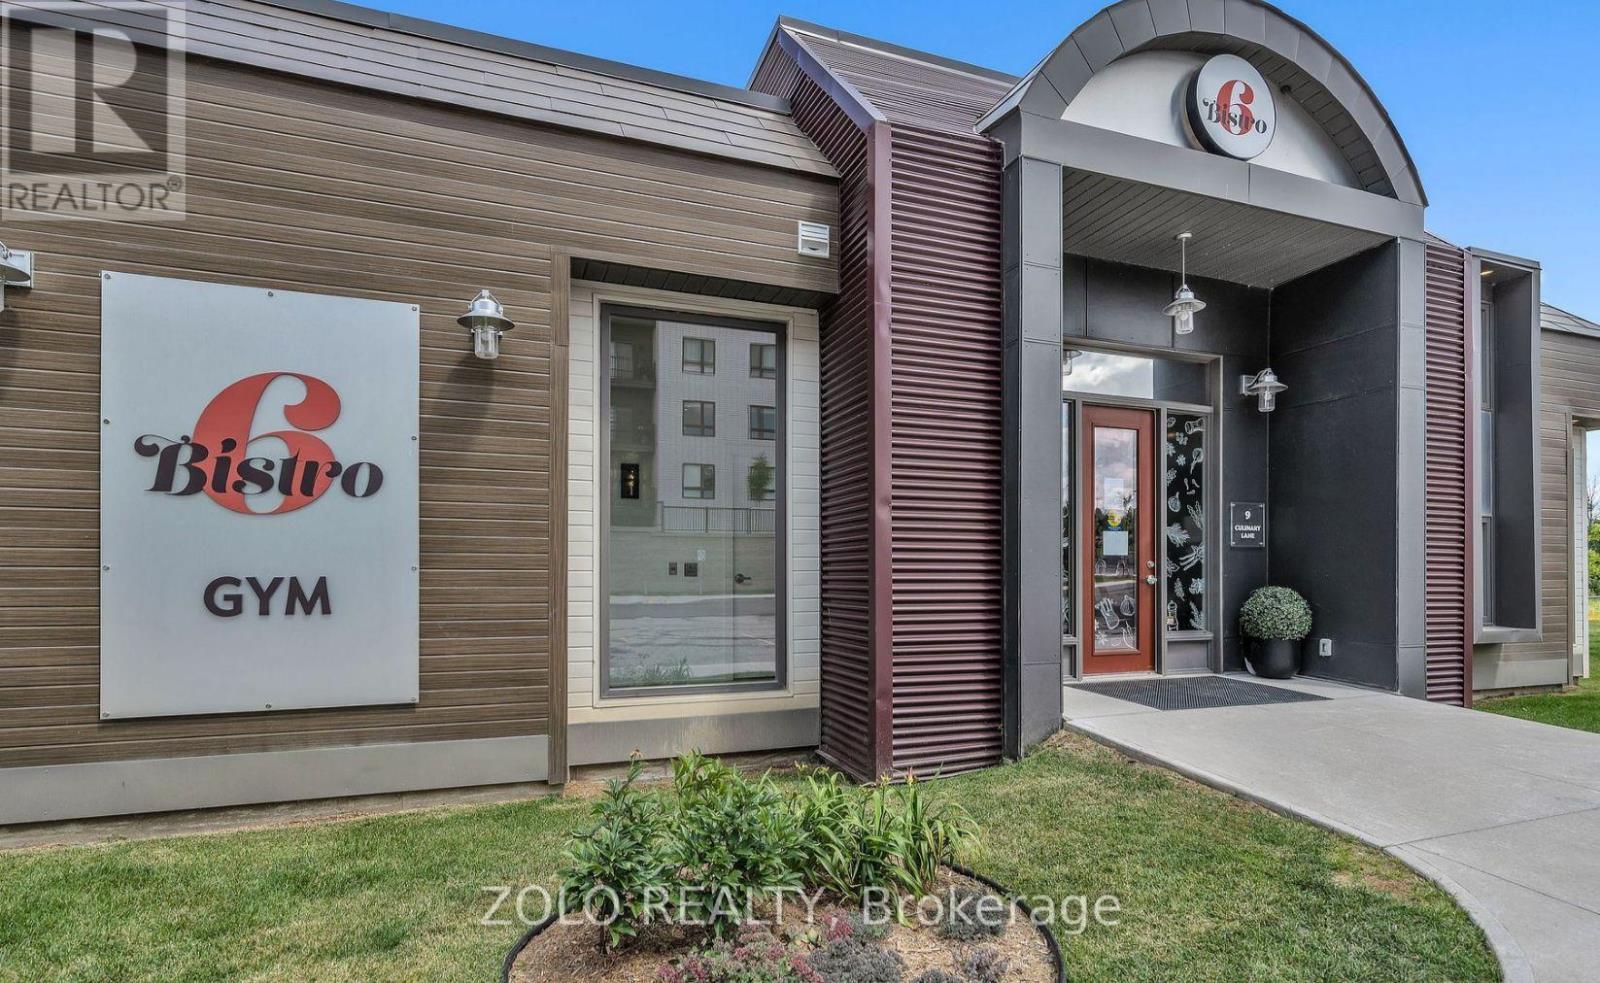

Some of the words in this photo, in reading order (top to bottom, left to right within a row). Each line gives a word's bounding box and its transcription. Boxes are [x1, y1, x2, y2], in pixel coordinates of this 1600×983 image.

[1203, 98, 1267, 134] Bistro
[192, 371, 342, 515] 6
[134, 434, 384, 498] Bistro
[1244, 510, 1251, 520] 9
[203, 576, 332, 618] GYM
